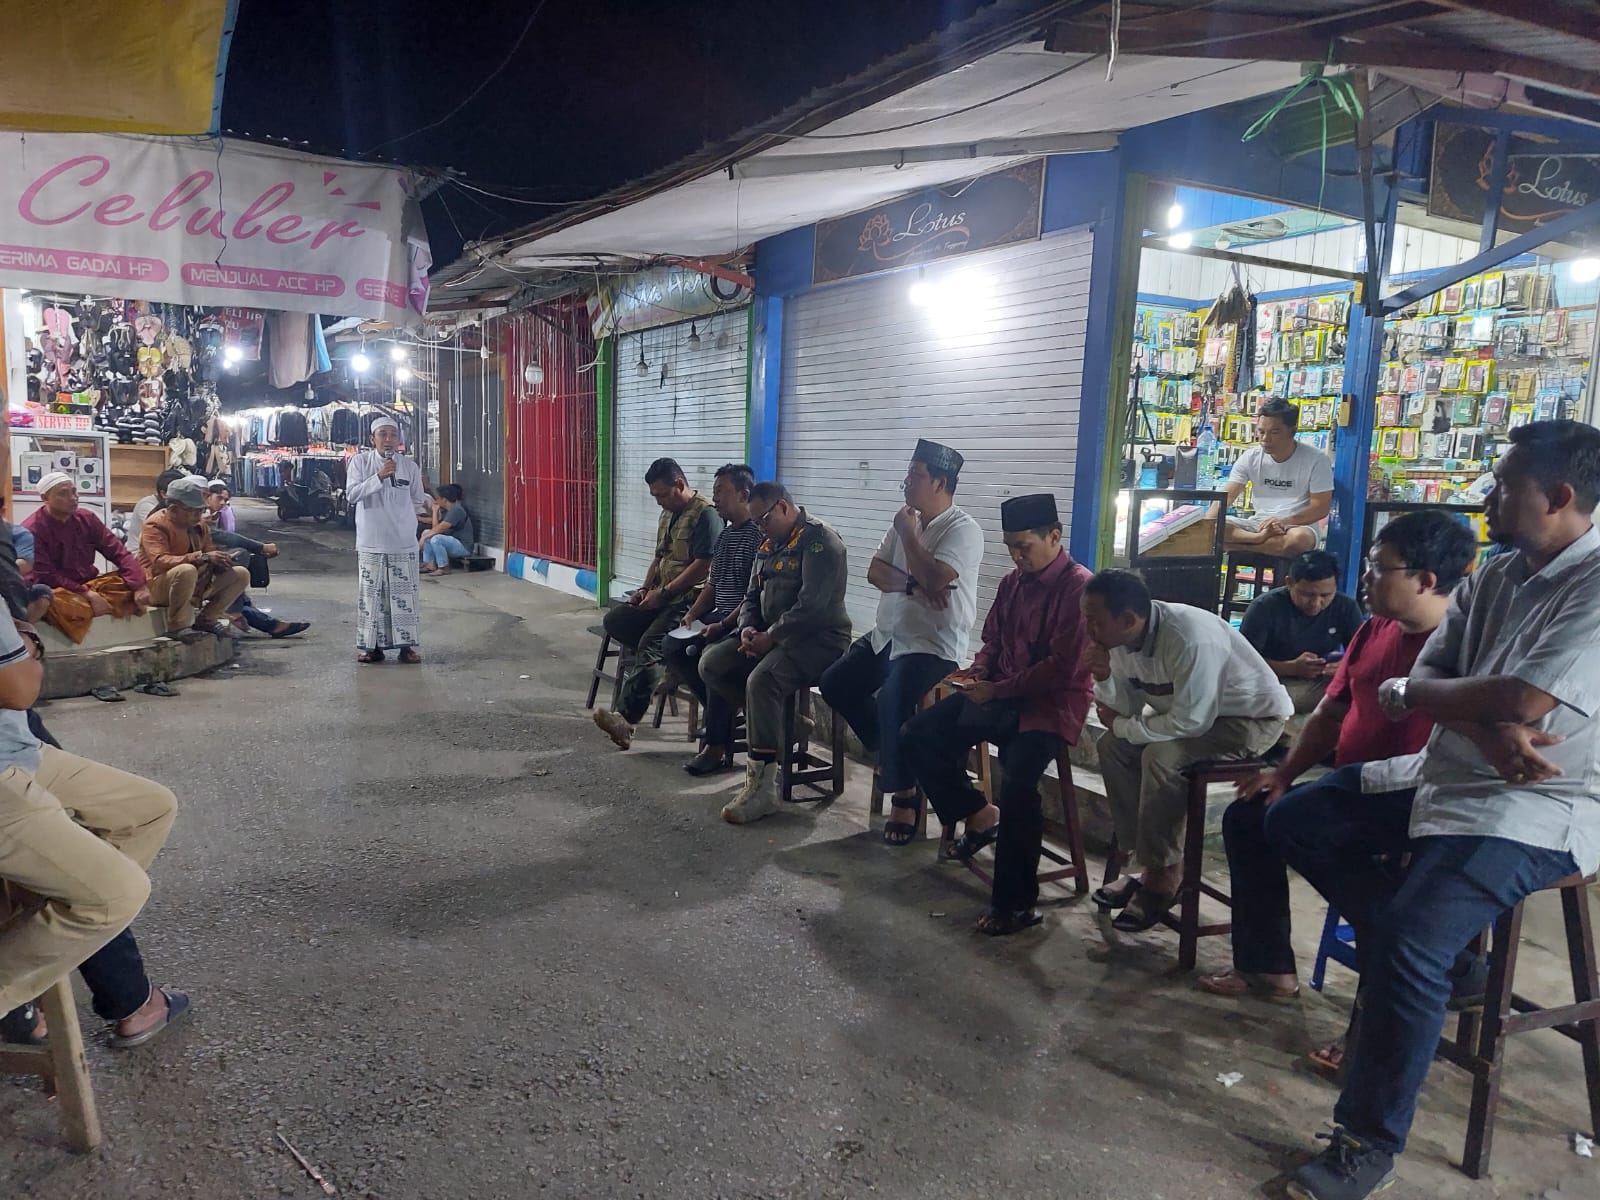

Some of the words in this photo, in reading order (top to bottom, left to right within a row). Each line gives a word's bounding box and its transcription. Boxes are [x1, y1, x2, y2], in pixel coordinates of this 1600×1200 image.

[1519, 157, 1588, 207] Lotus
[18, 155, 366, 249] Celuler
[893, 202, 967, 241] Lotus
[66, 256, 121, 274] GADAI
[129, 261, 153, 276] HP
[190, 268, 270, 287] MENJUAL
[276, 277, 308, 290] ACC
[314, 280, 336, 291] HP
[38, 415, 72, 429] SERVIS
[1264, 478, 1293, 487] POLICE
